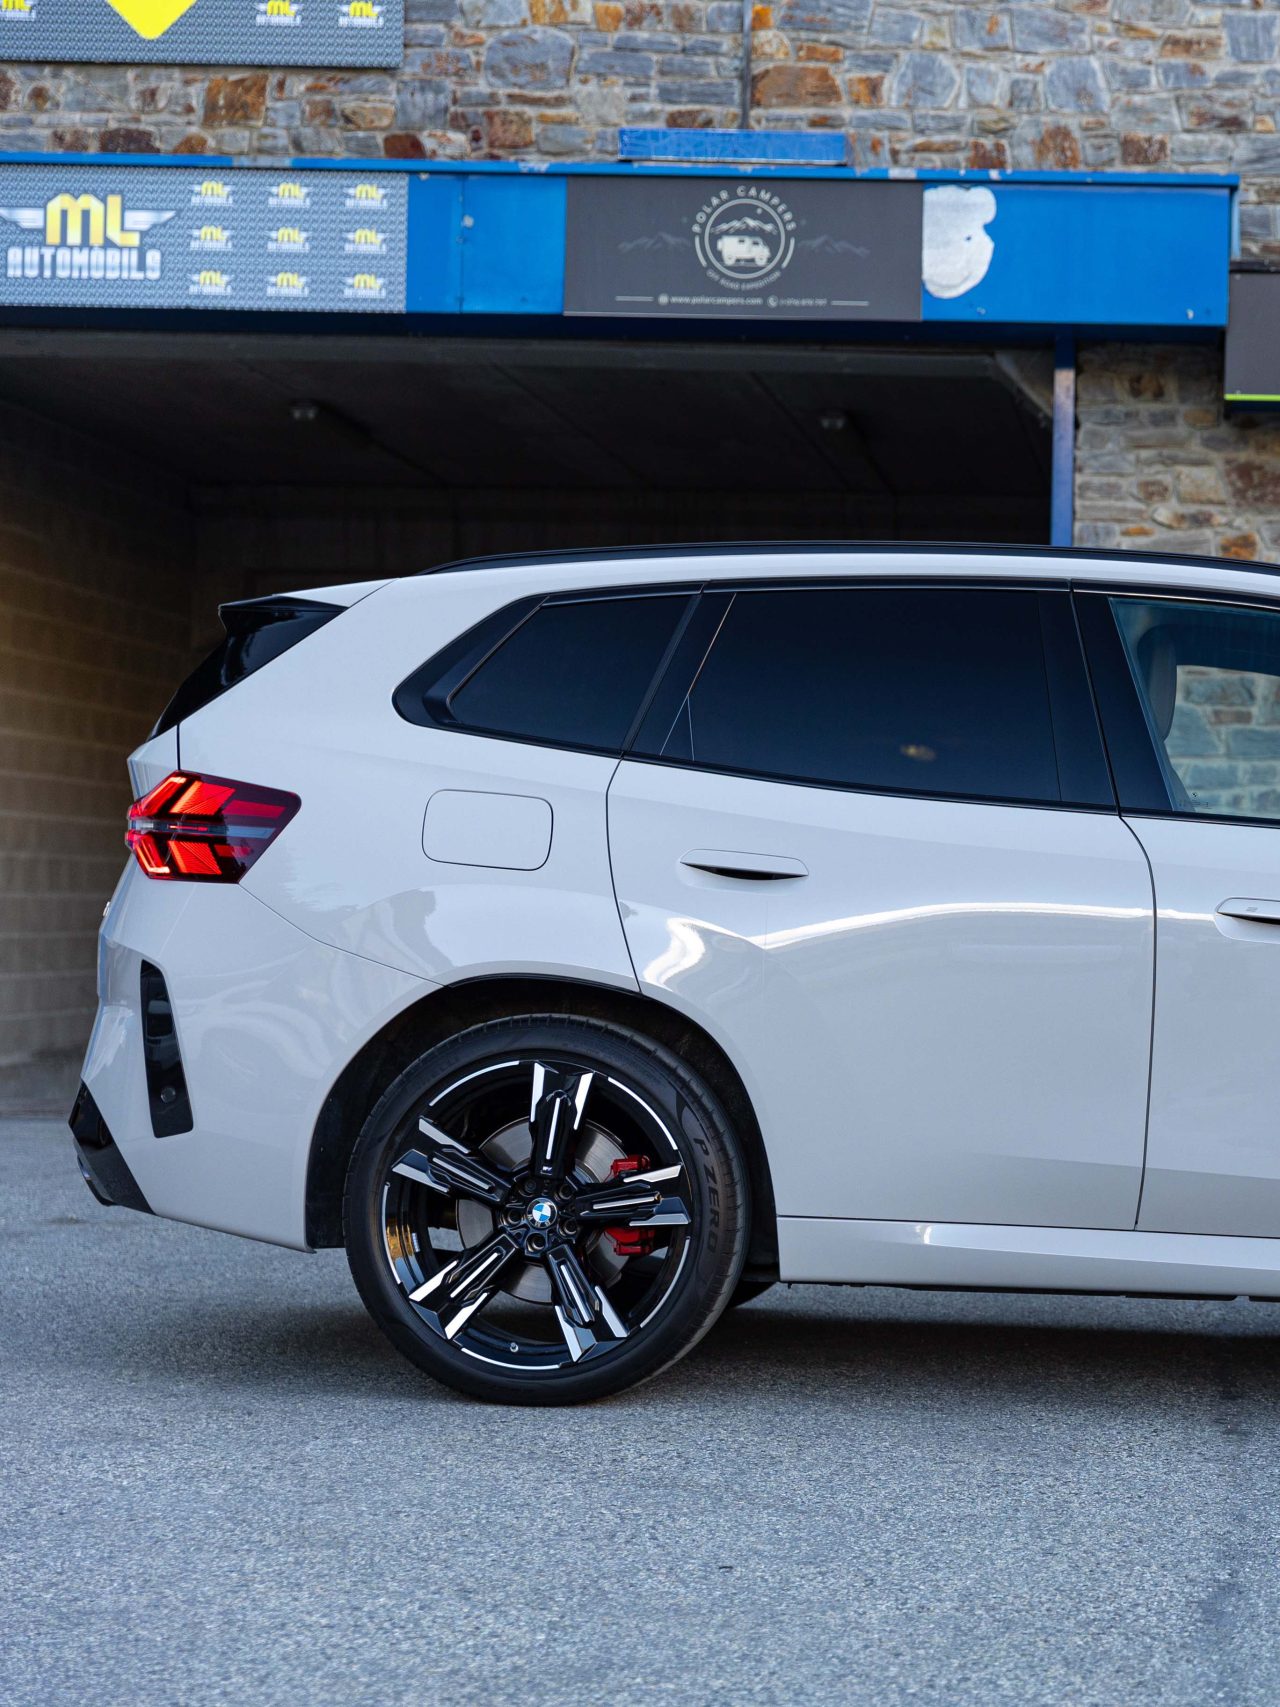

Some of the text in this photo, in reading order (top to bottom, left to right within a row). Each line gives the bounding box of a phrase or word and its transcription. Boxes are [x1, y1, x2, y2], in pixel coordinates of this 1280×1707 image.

[266, 0, 296, 17] ML
[349, 1, 378, 17] ML
[46, 193, 140, 247] ML
[692, 185, 797, 233] POLAR CAMPERS
[693, 1137, 722, 1253] P ZERO
